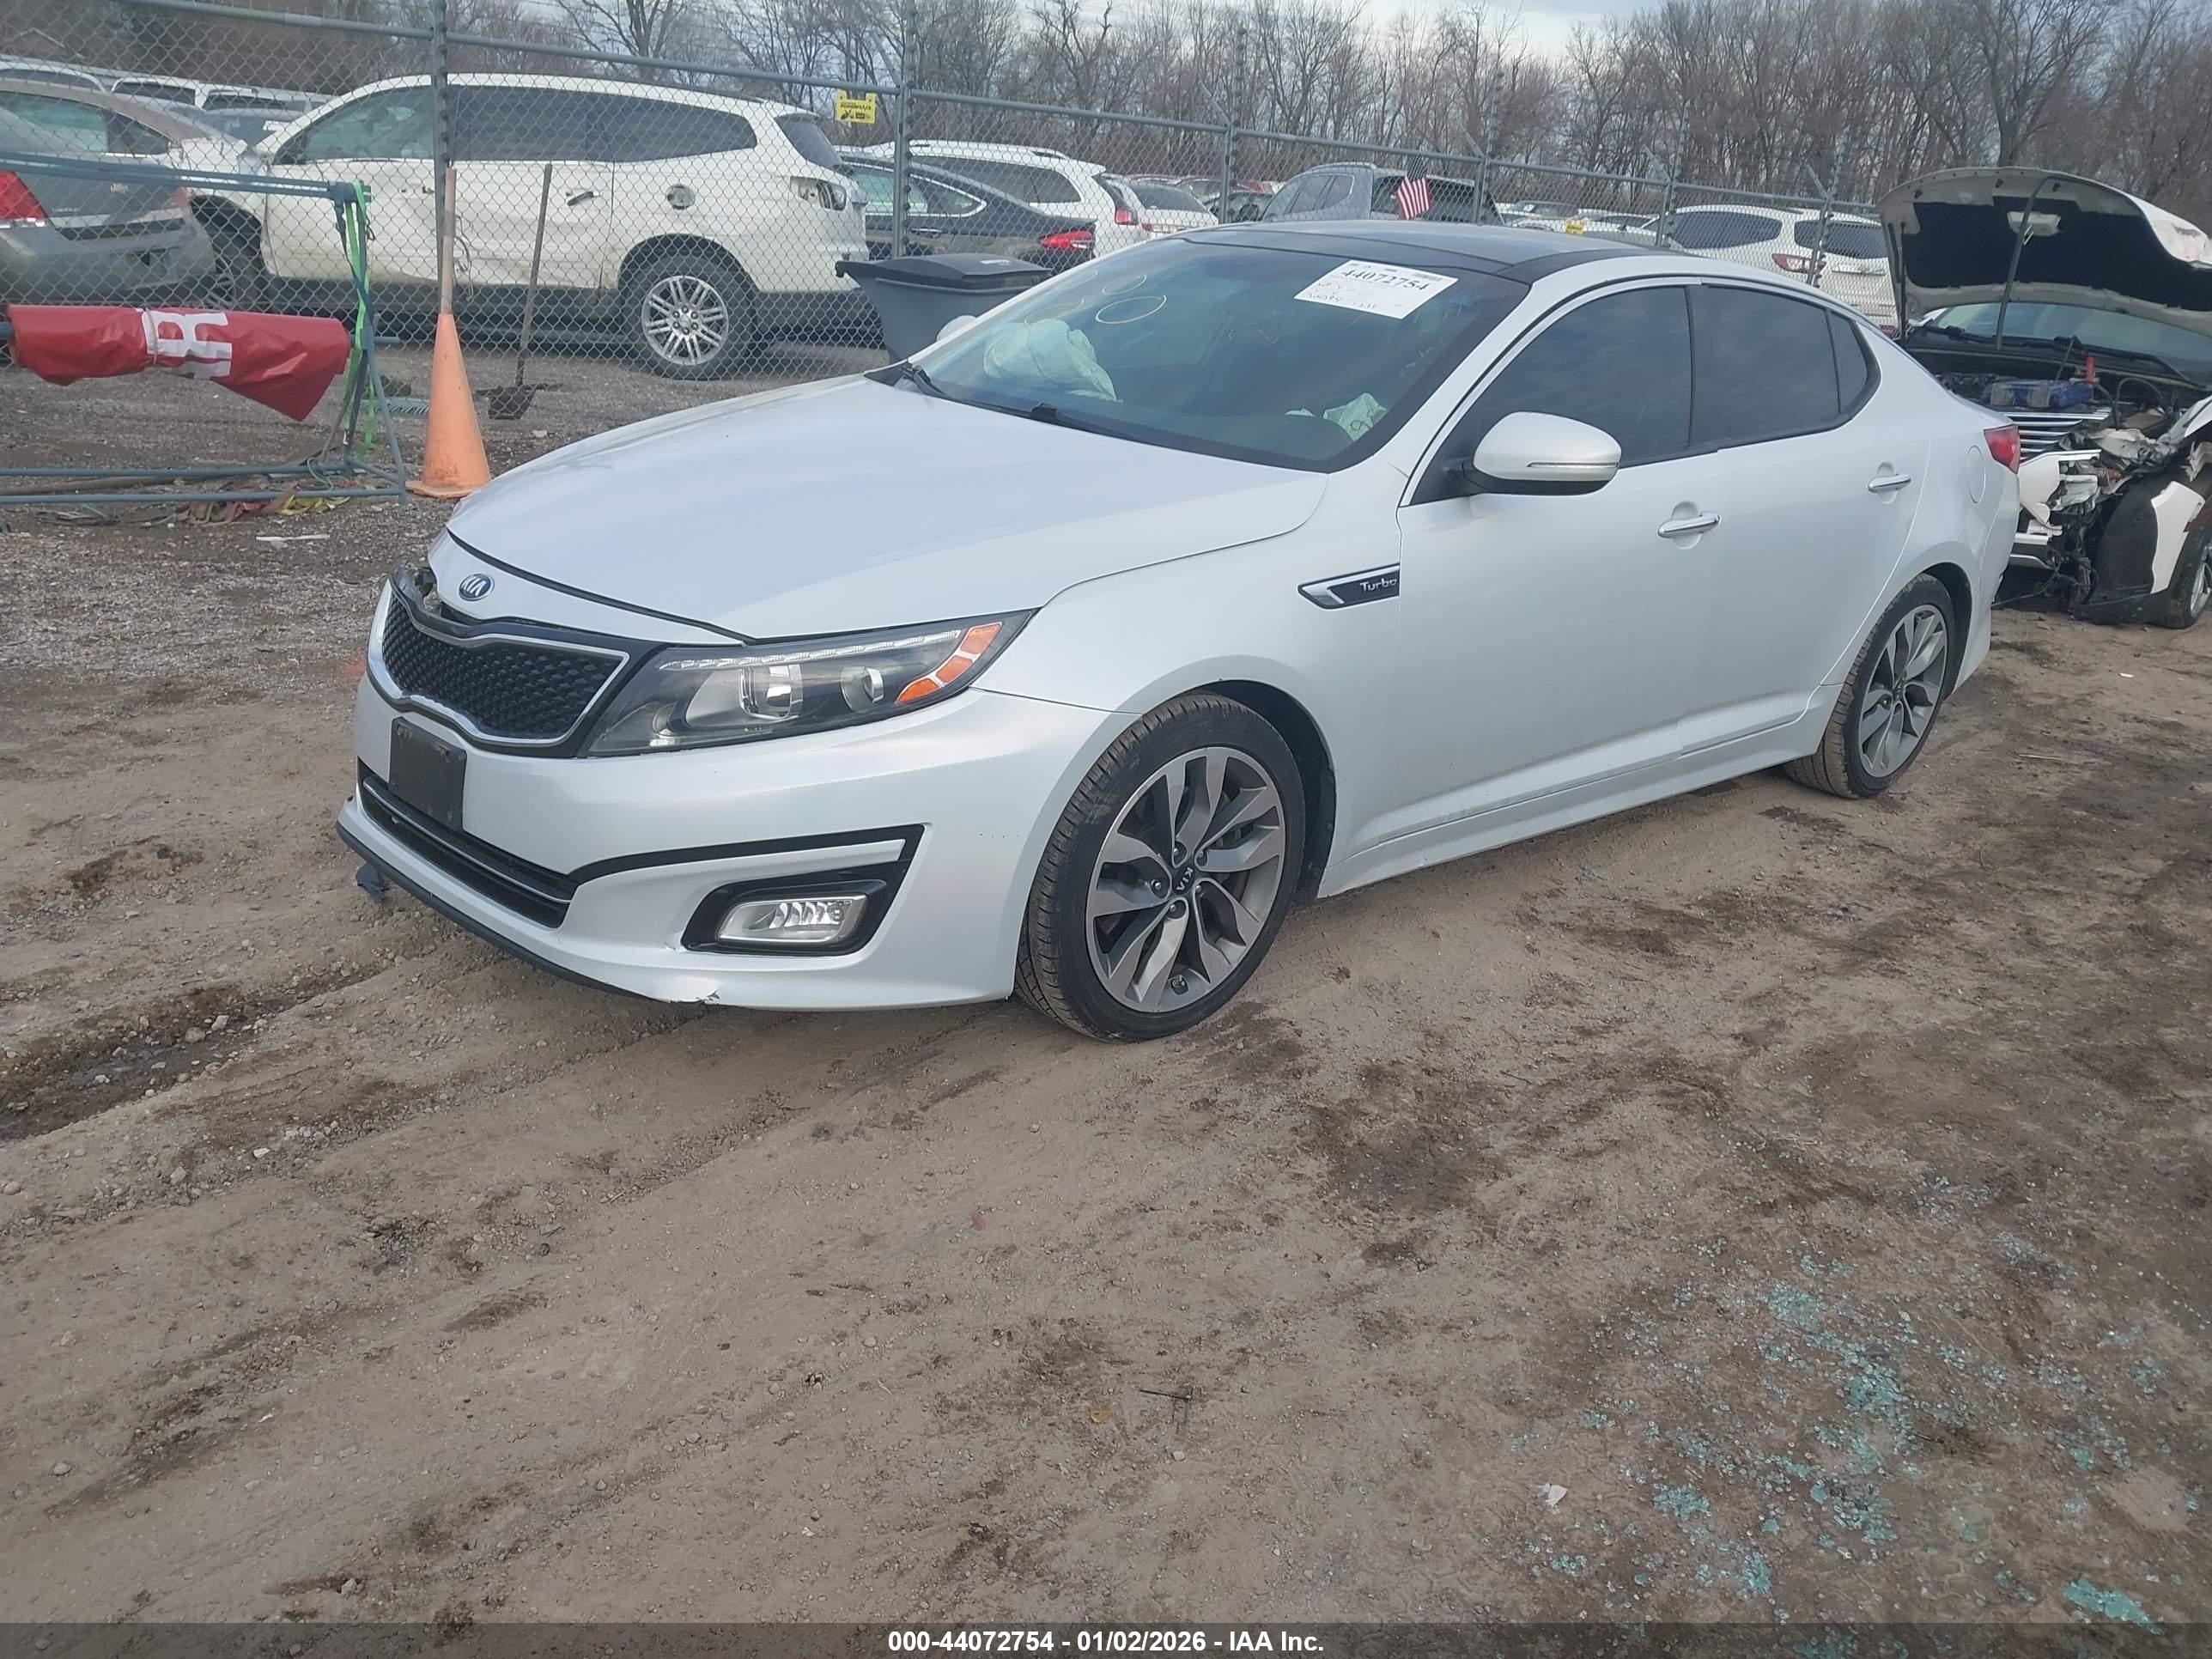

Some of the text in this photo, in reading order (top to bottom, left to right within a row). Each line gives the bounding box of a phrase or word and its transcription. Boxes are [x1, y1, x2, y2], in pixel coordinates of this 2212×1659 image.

[1341, 270, 1430, 290] 44072754
[461, 576, 488, 597] KIA
[1360, 578, 1397, 592] Turbo
